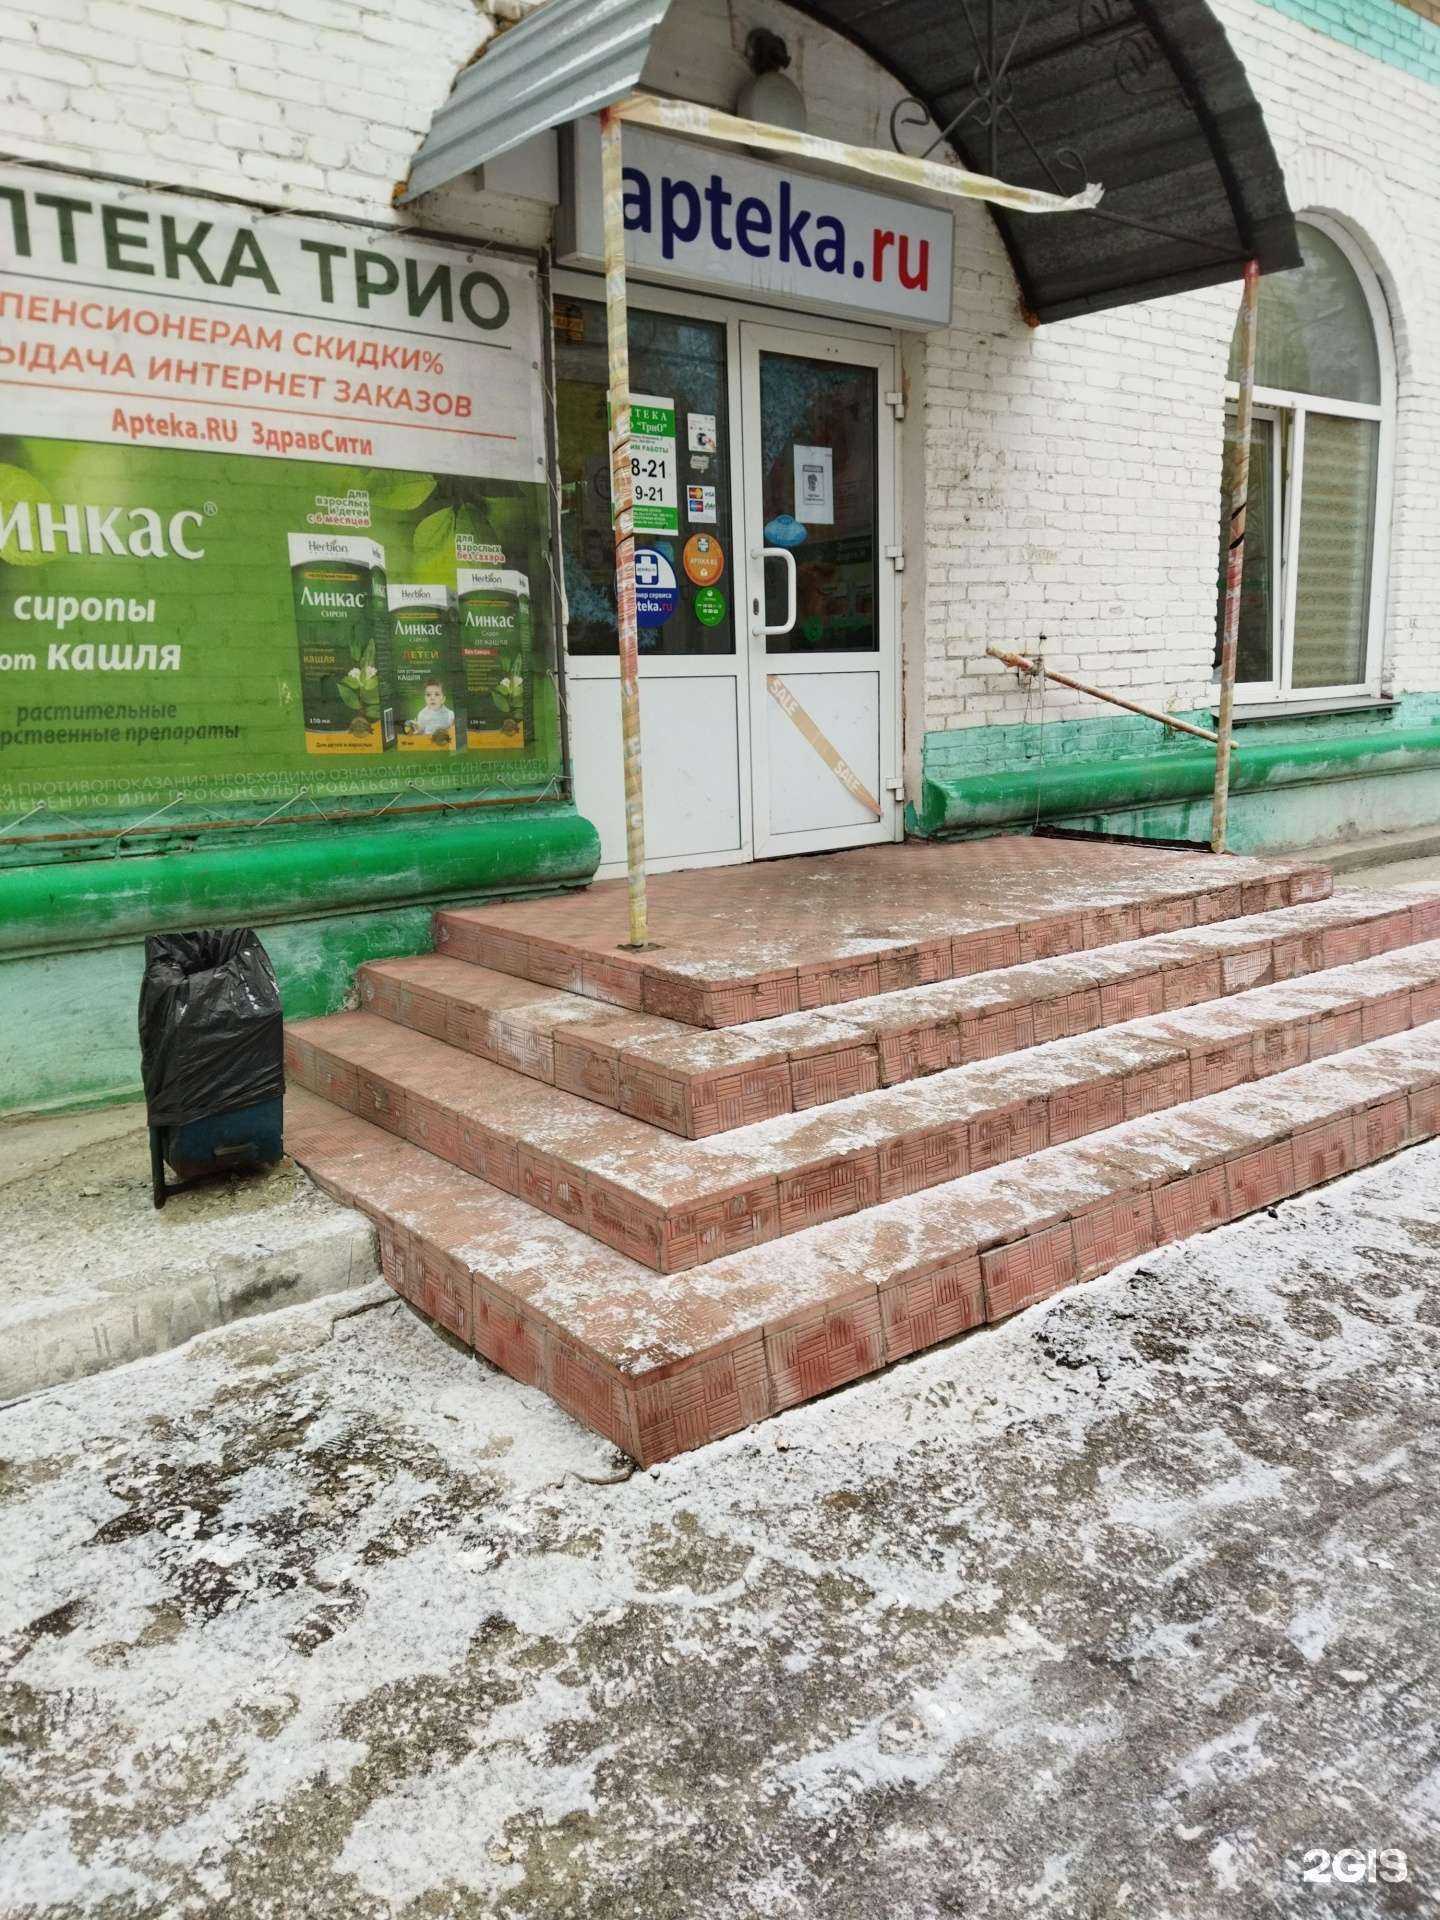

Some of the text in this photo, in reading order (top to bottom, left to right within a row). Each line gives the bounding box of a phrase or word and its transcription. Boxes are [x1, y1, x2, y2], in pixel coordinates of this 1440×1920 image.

[622, 167, 930, 292] apteka.ru
[301, 238, 512, 331] ТРИО
[0, 291, 444, 376] ПЕНСИОНЕРАМ СКИДКИ%
[149, 356, 326, 401] ИНТЕРНЕТ
[334, 379, 473, 419] ЗАКАЗОВ
[630, 408, 668, 421] ТЕКА
[112, 408, 373, 457] Apteka.RU ЗдравСити
[631, 458, 666, 479] 8-21
[635, 485, 664, 502] 9-21
[308, 539, 348, 553] Herbion
[300, 586, 366, 608] Линкас
[636, 600, 672, 612] teka.ru
[14, 595, 156, 629] сиропы
[465, 611, 515, 628] Линкас
[394, 620, 443, 636] Линкас
[0, 643, 182, 671] от кашля
[16, 704, 178, 726] растительные
[126, 724, 241, 745] препараты
[1, 793, 108, 811] МЕЕНИЮ
